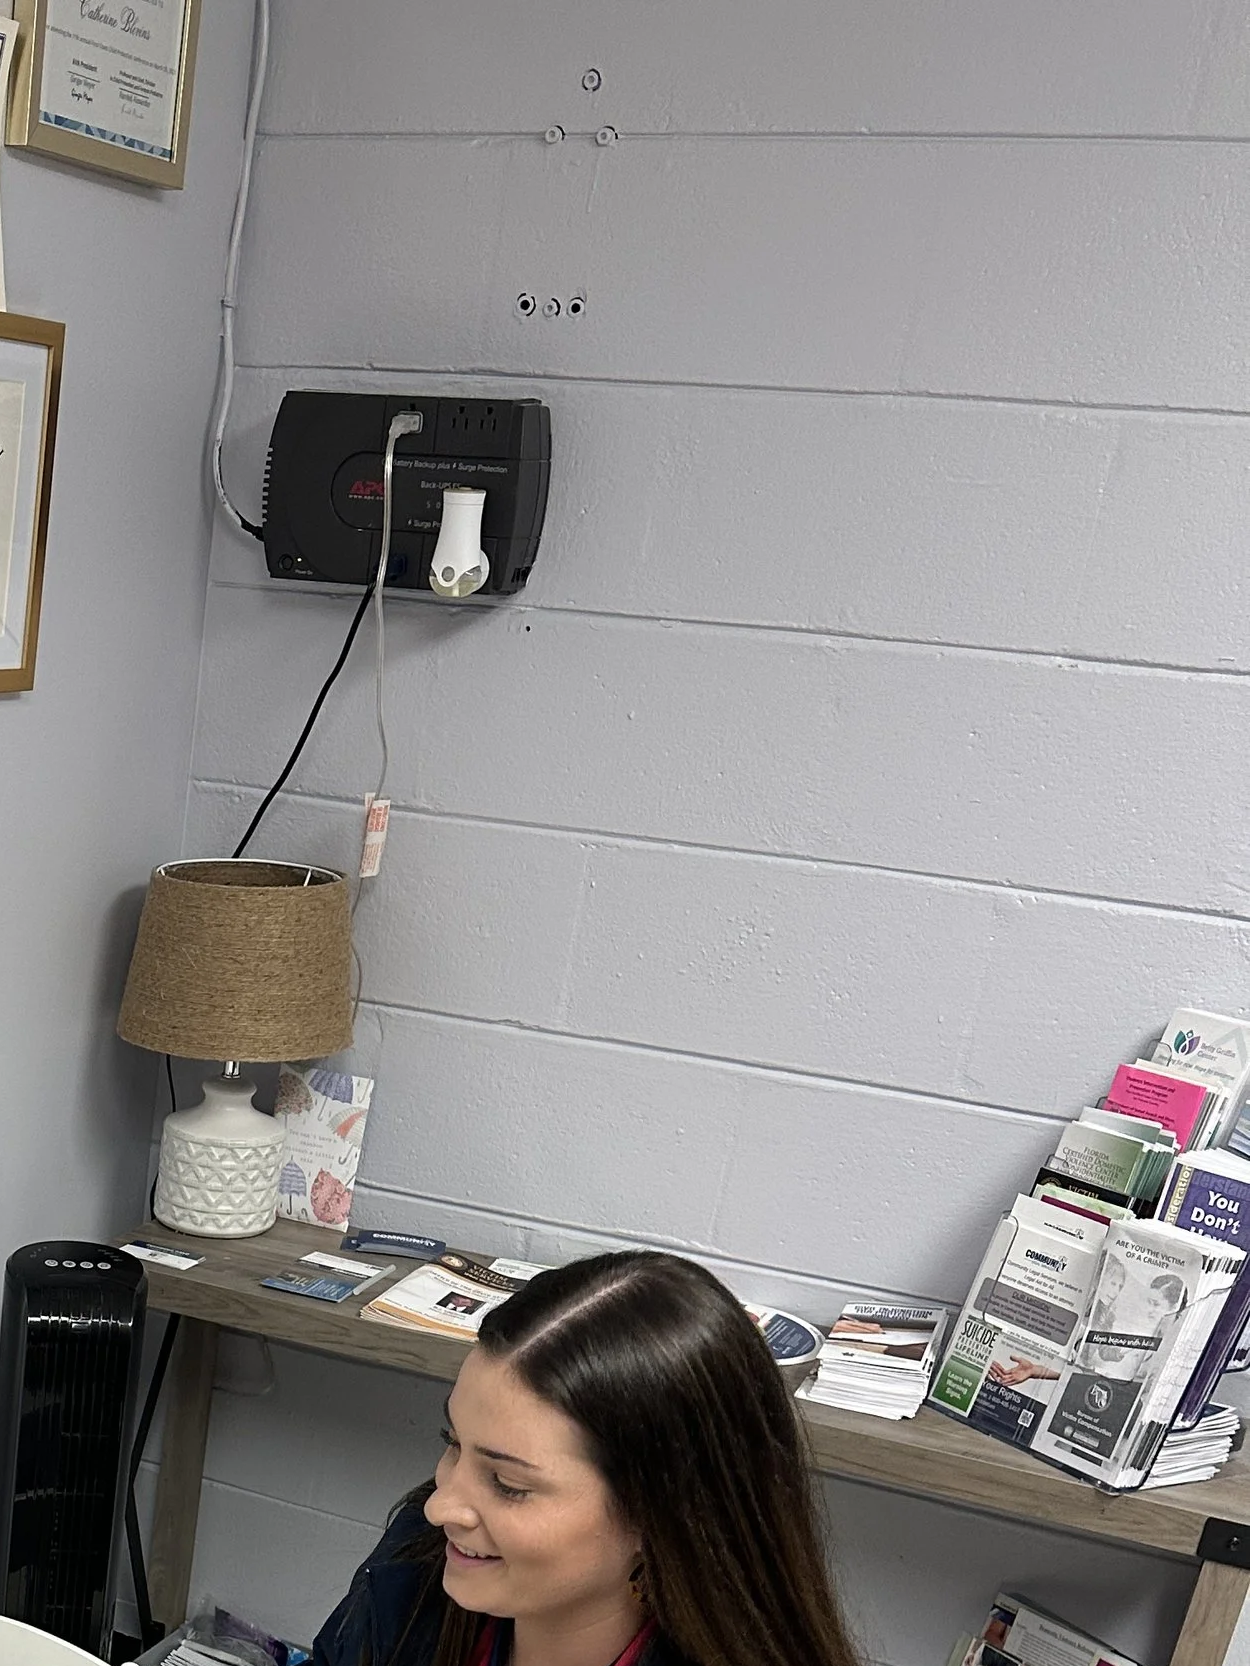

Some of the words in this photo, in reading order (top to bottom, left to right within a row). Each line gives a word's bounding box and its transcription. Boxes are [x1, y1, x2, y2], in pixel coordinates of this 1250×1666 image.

[80, 0, 118, 28] Catherine
[120, 6, 152, 41] Blevins
[458, 463, 476, 471] Surge
[477, 464, 508, 473] Protection
[1083, 1146, 1109, 1159] FLORIDA
[1094, 1156, 1126, 1173] DOMESTIC
[1208, 1190, 1240, 1214] You
[1190, 1206, 1241, 1235] Don't
[1116, 1239, 1130, 1249] ARE
[1130, 1244, 1147, 1254] YOU
[1147, 1249, 1161, 1259] THE
[1161, 1254, 1185, 1267] VICTIM
[1135, 1254, 1143, 1262] A
[961, 1320, 998, 1348] SUICIDE
[955, 1343, 989, 1362] LIFELINE
[958, 1336, 992, 1355] PREVENTION
[946, 1379, 968, 1395] Warning
[947, 1371, 962, 1382] Learn
[962, 1377, 973, 1386] the
[999, 1386, 1022, 1404] Rights
